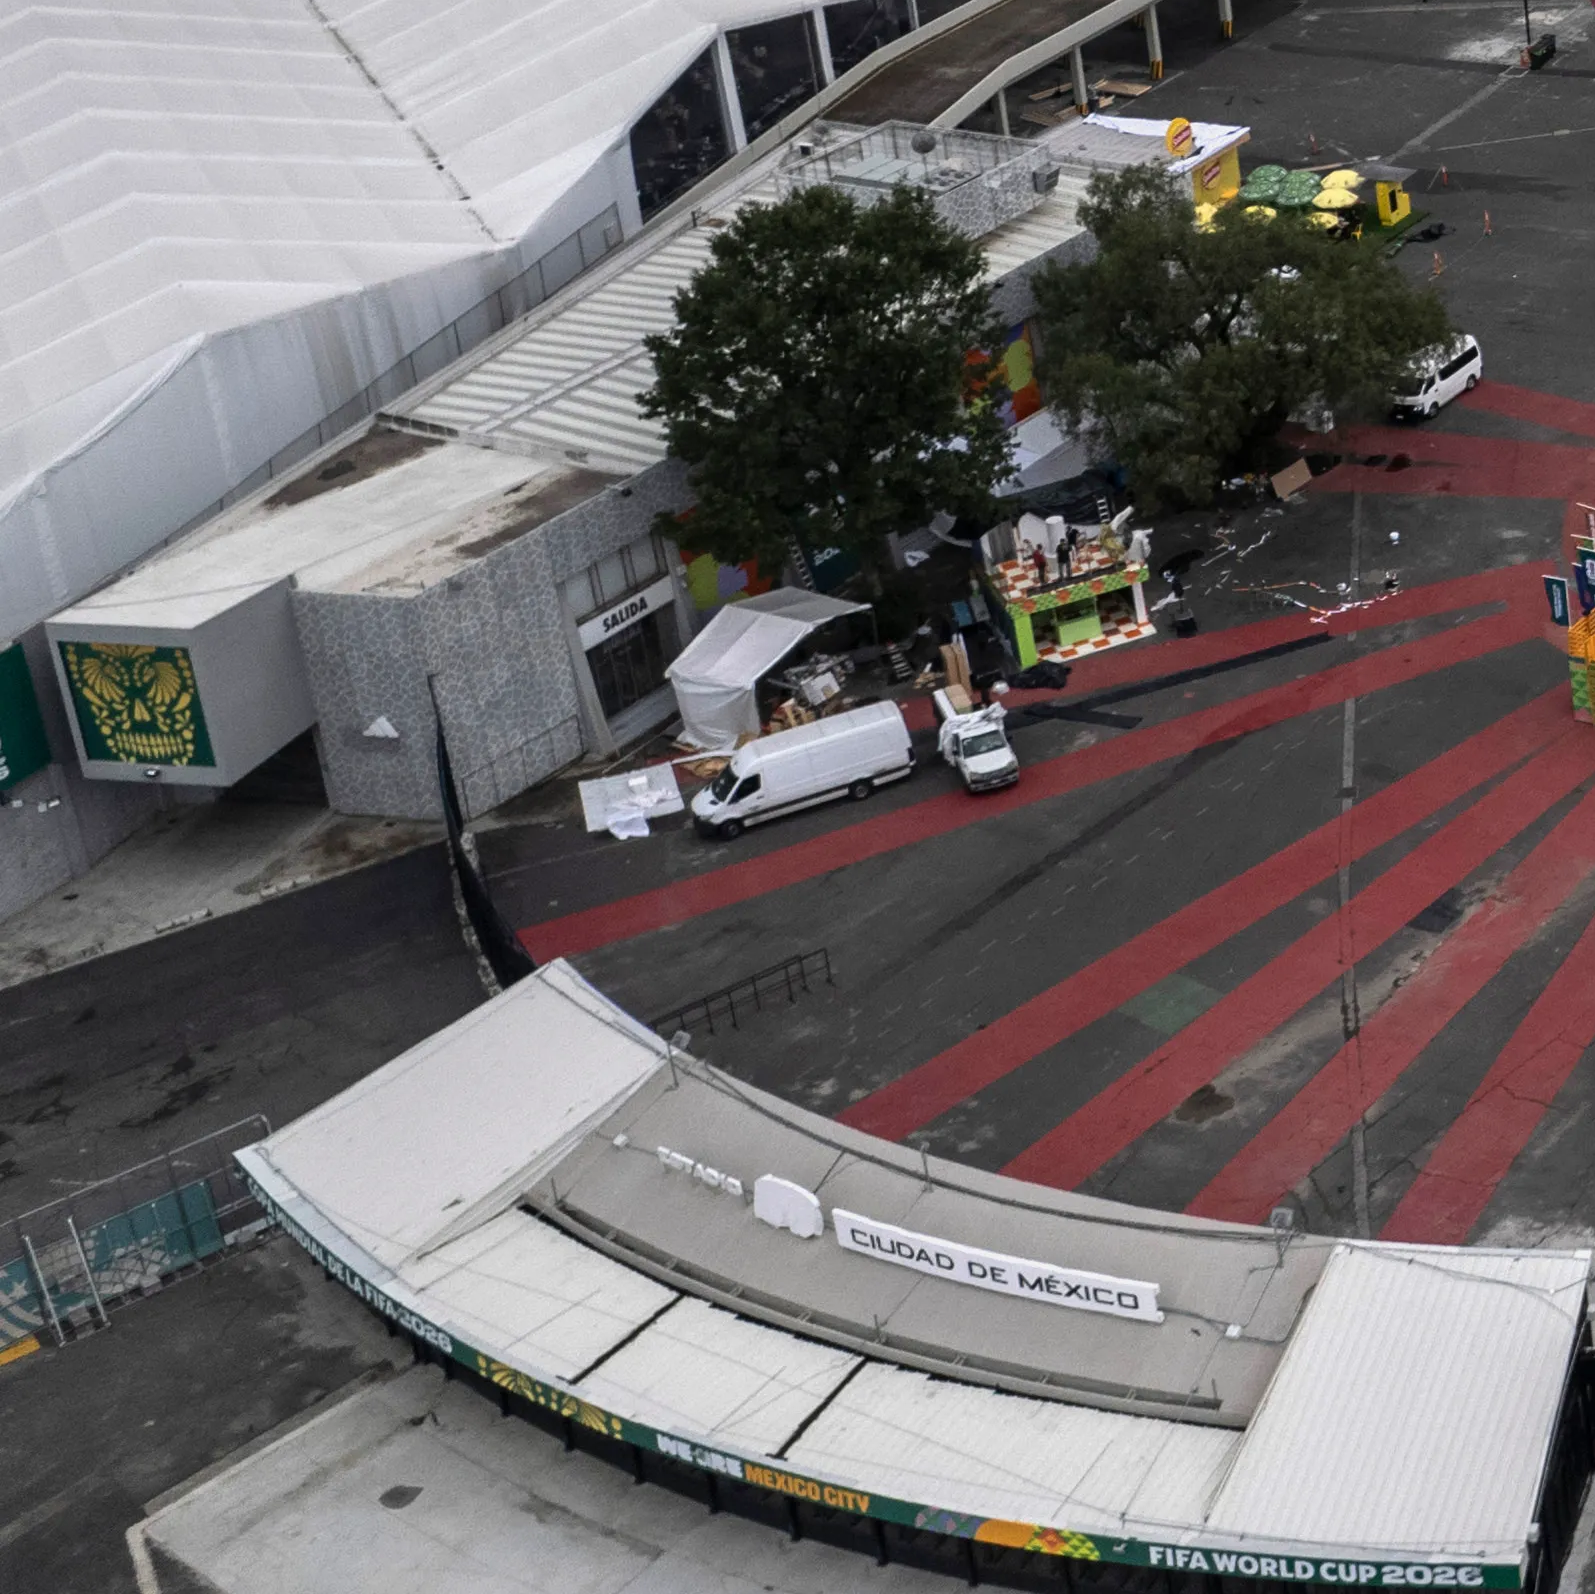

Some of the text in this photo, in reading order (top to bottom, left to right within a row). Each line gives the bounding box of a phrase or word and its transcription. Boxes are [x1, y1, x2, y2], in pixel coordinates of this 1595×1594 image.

[603, 596, 648, 633] SALIDA
[850, 1227, 1139, 1310] CIUDAD DE MÉXICO
[328, 1257, 345, 1282] DE
[345, 1269, 369, 1298] LA
[365, 1280, 397, 1320] FIFA
[399, 1303, 453, 1354] 2026
[744, 1462, 821, 1502] MEXICO
[824, 1487, 870, 1513] CITY
[1148, 1546, 1484, 1587] FIFA WORLD CUP 2026
